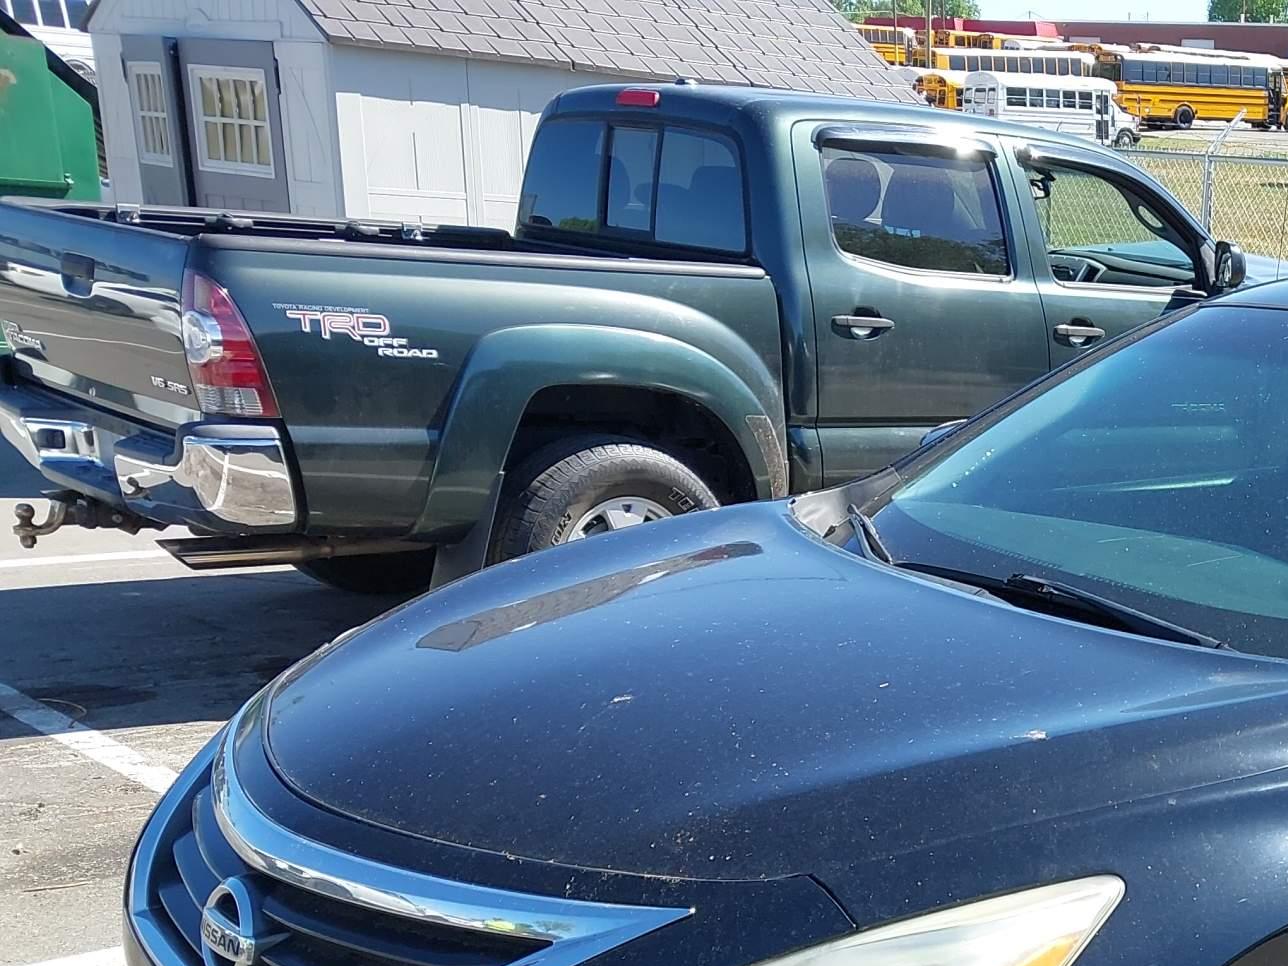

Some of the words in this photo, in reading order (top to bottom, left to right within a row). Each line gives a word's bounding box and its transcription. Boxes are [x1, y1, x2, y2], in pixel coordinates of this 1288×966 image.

[324, 305, 369, 313] DEVELOPMENT
[286, 310, 391, 341] TRD
[363, 337, 409, 347] OFF
[377, 347, 439, 358] ROAD
[150, 375, 165, 388] V6
